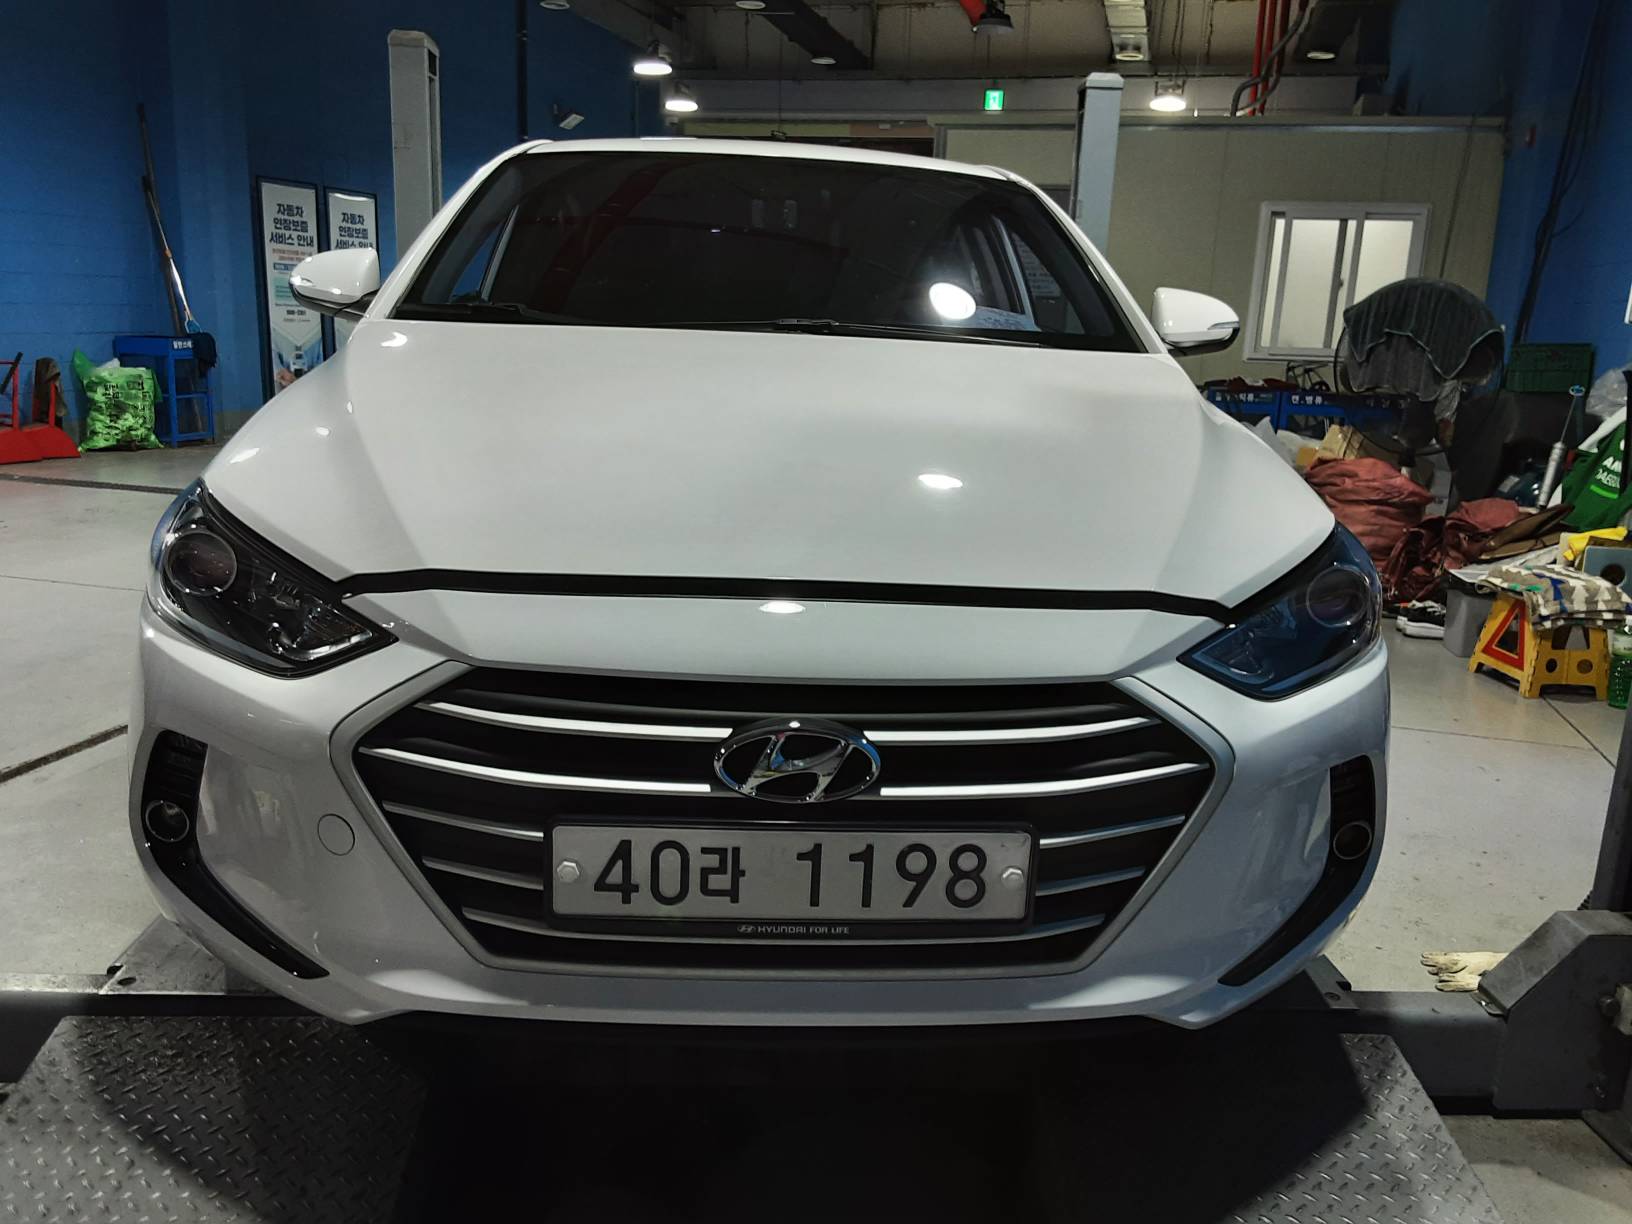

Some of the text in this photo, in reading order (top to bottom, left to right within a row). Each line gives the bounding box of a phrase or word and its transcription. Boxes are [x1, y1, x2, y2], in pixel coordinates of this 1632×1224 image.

[277, 203, 304, 218] 자동차
[273, 217, 309, 233] 연장보증
[341, 212, 365, 226] 자동차
[269, 231, 314, 248] 서비스 안내
[338, 226, 369, 240] 연장보증
[593, 838, 987, 909] 40라 1198
[758, 925, 850, 935] HYUNDAI FOR LIFE
